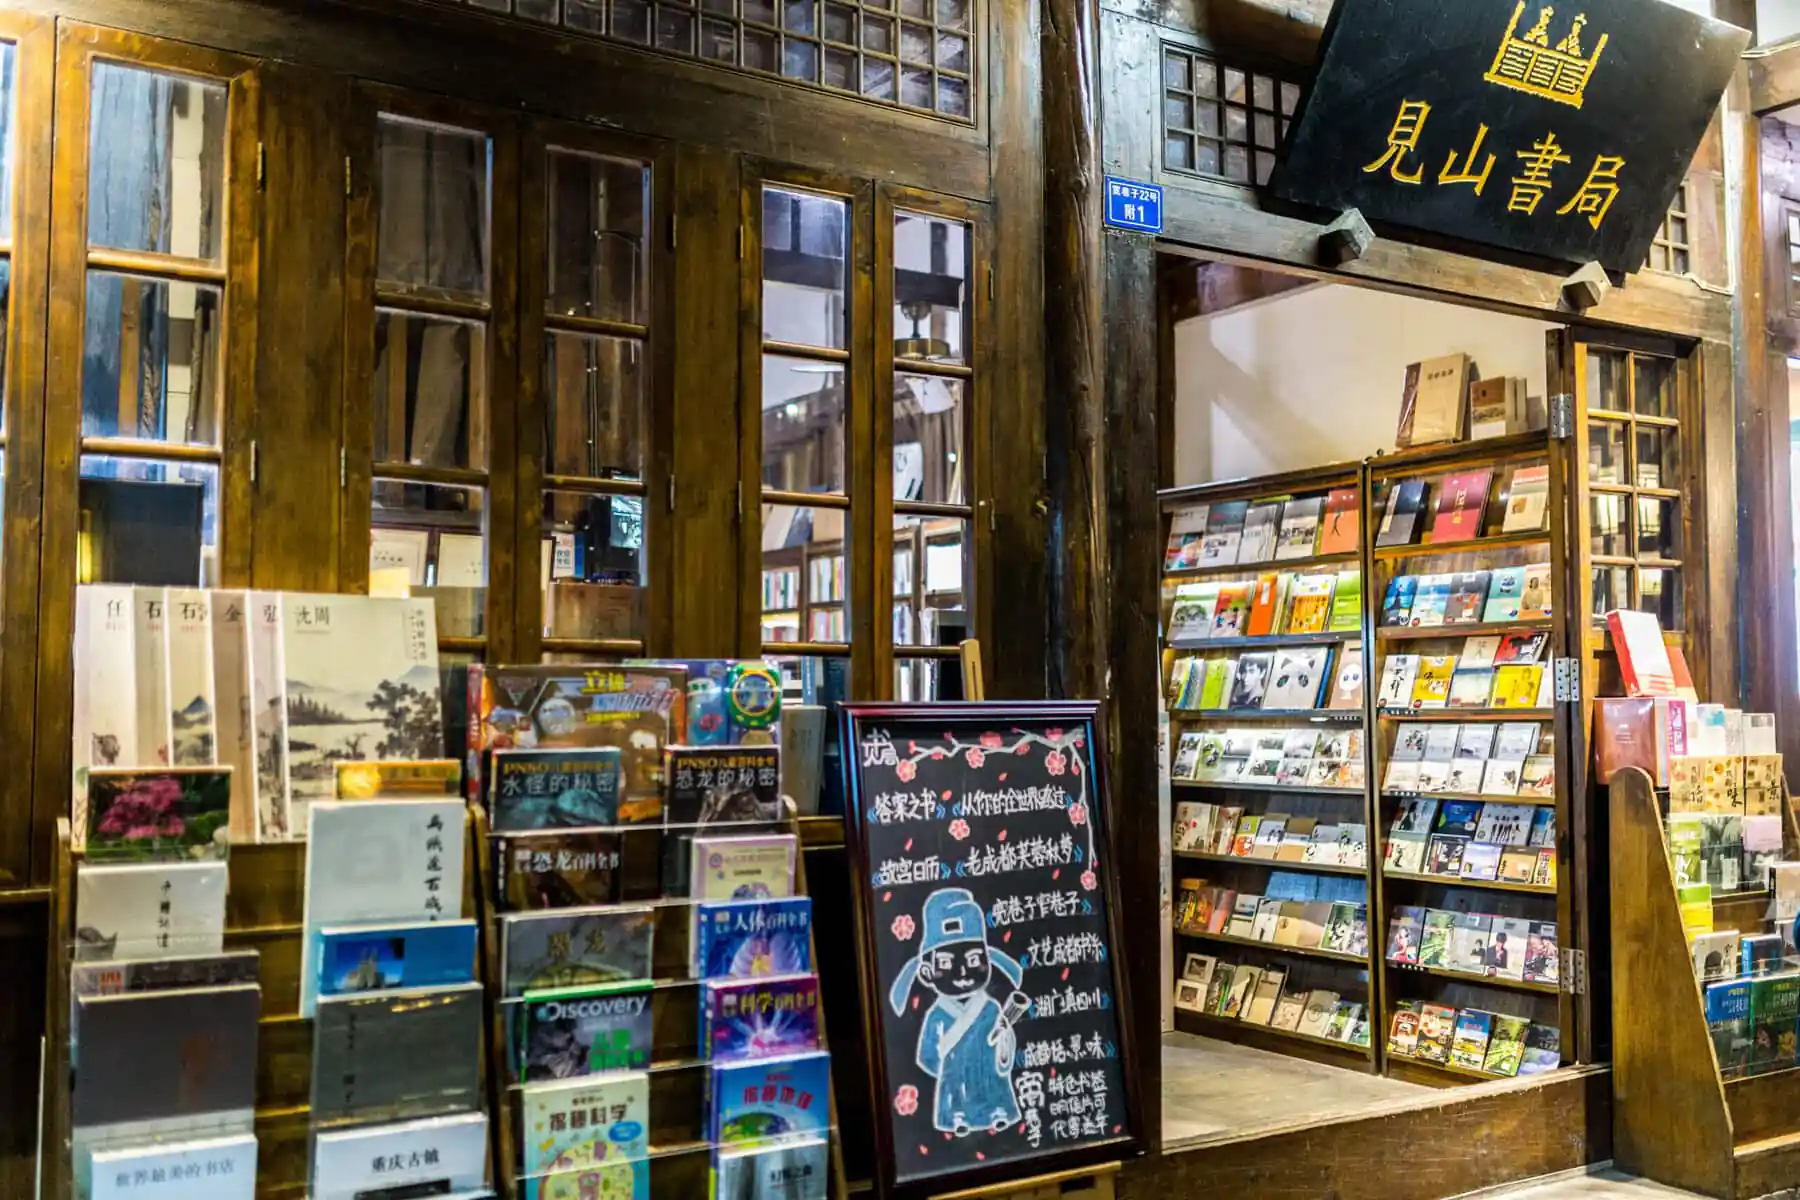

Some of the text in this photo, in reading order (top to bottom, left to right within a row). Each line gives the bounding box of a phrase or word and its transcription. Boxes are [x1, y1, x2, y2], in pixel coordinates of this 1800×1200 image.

[1362, 98, 1626, 230] 見山書局
[1124, 203, 1145, 223] 附1
[295, 605, 330, 626] 沈周
[502, 772, 615, 796] 水怪的秘密
[675, 767, 777, 789] 恐龙的秘密
[371, 1148, 439, 1173] 重庆古镇
